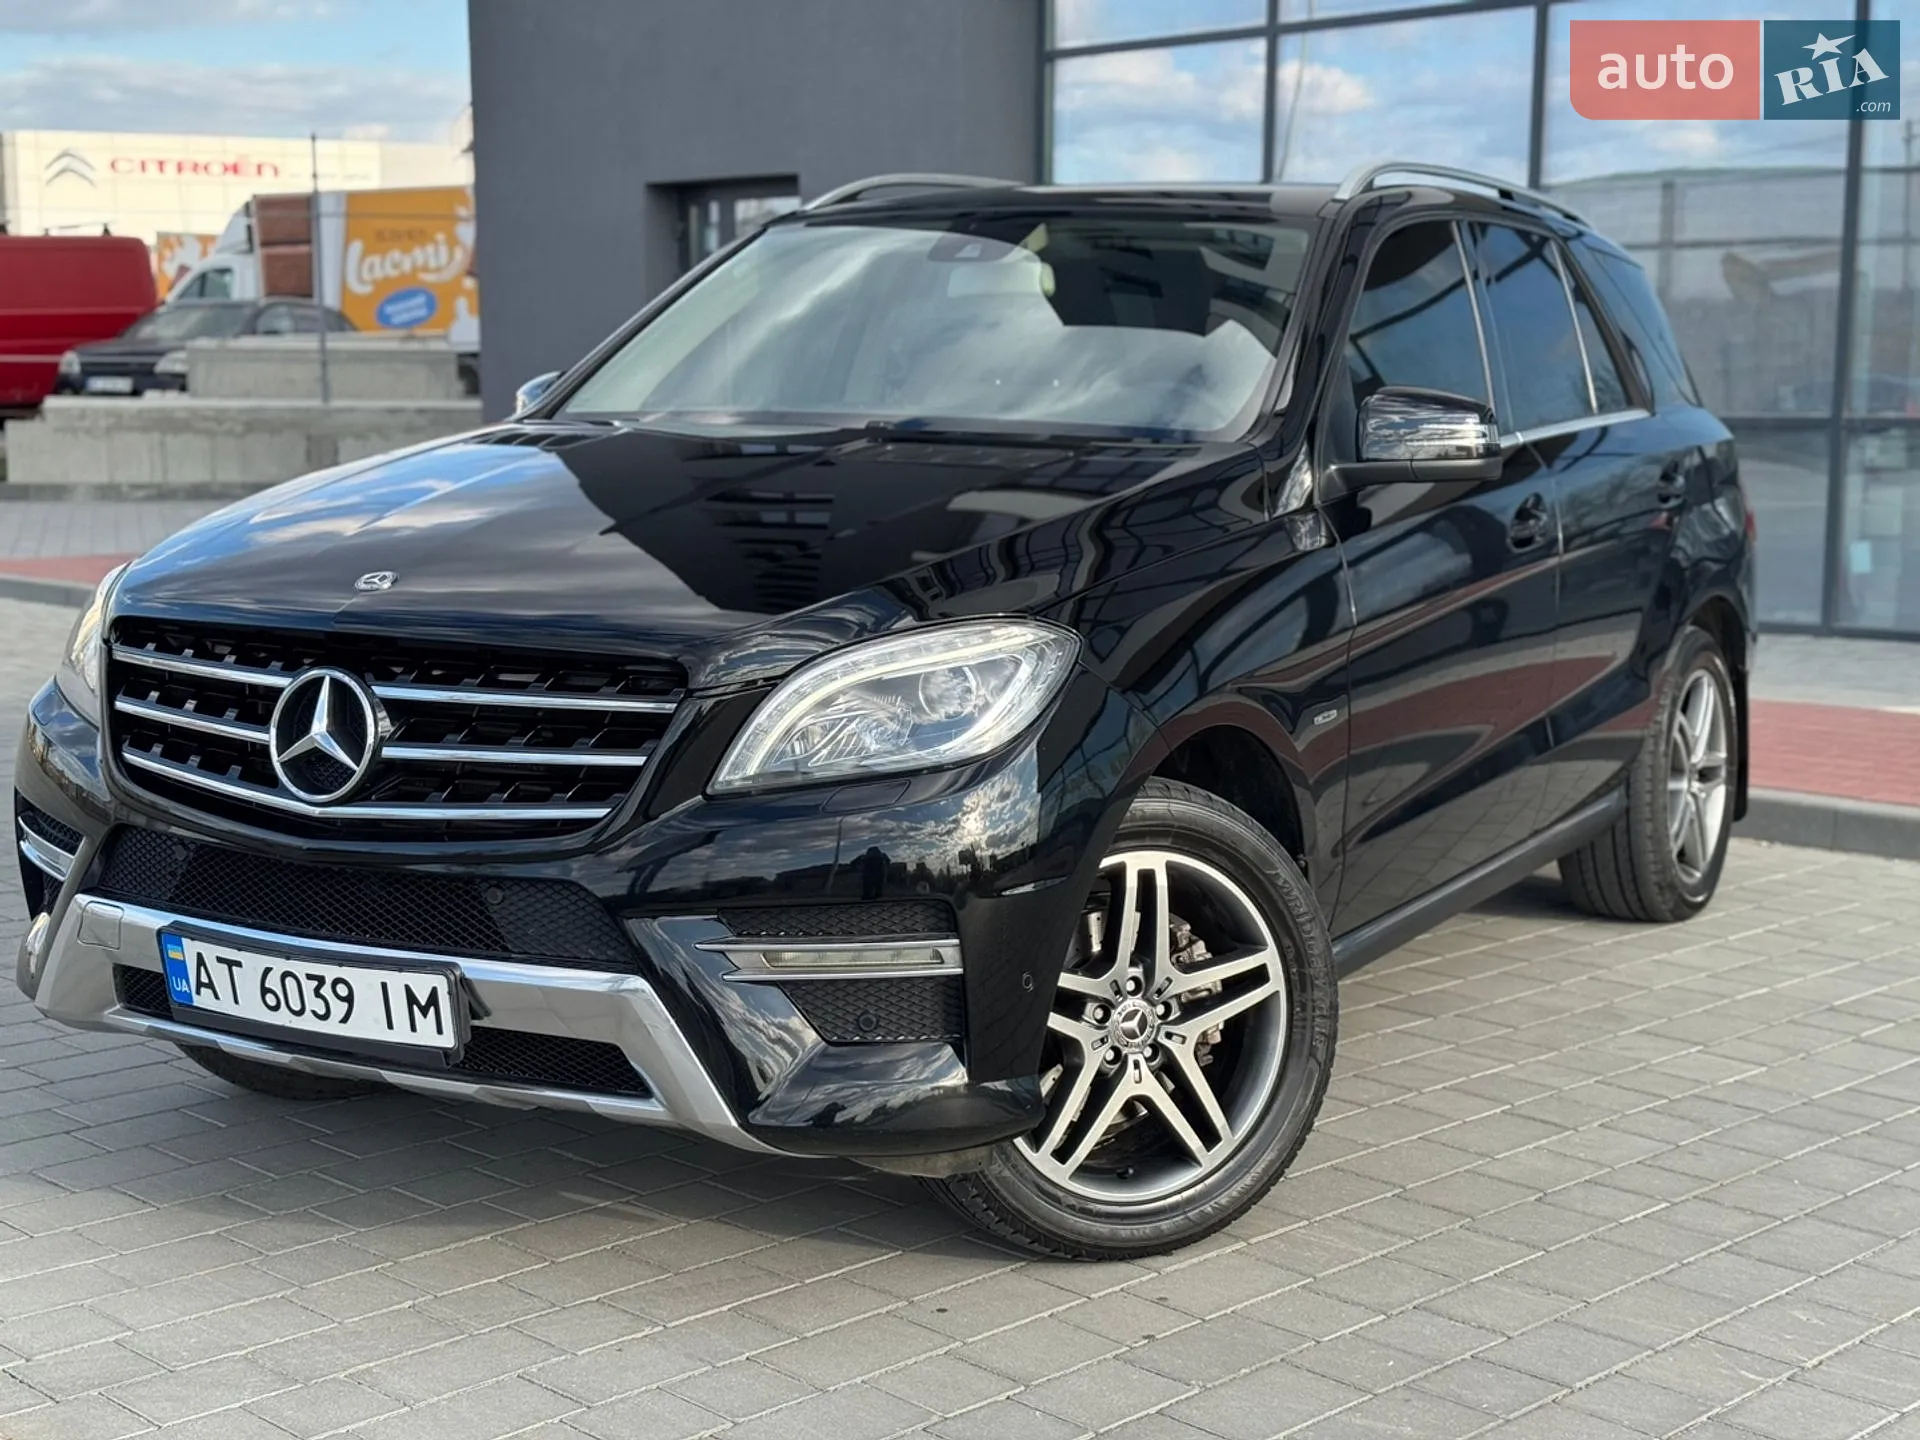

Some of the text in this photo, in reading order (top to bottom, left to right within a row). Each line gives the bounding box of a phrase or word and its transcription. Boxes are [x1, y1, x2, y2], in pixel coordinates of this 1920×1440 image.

[346, 232, 458, 295] Lacmi
[172, 975, 190, 994] UA
[195, 951, 445, 1036] AT 6039 IM
